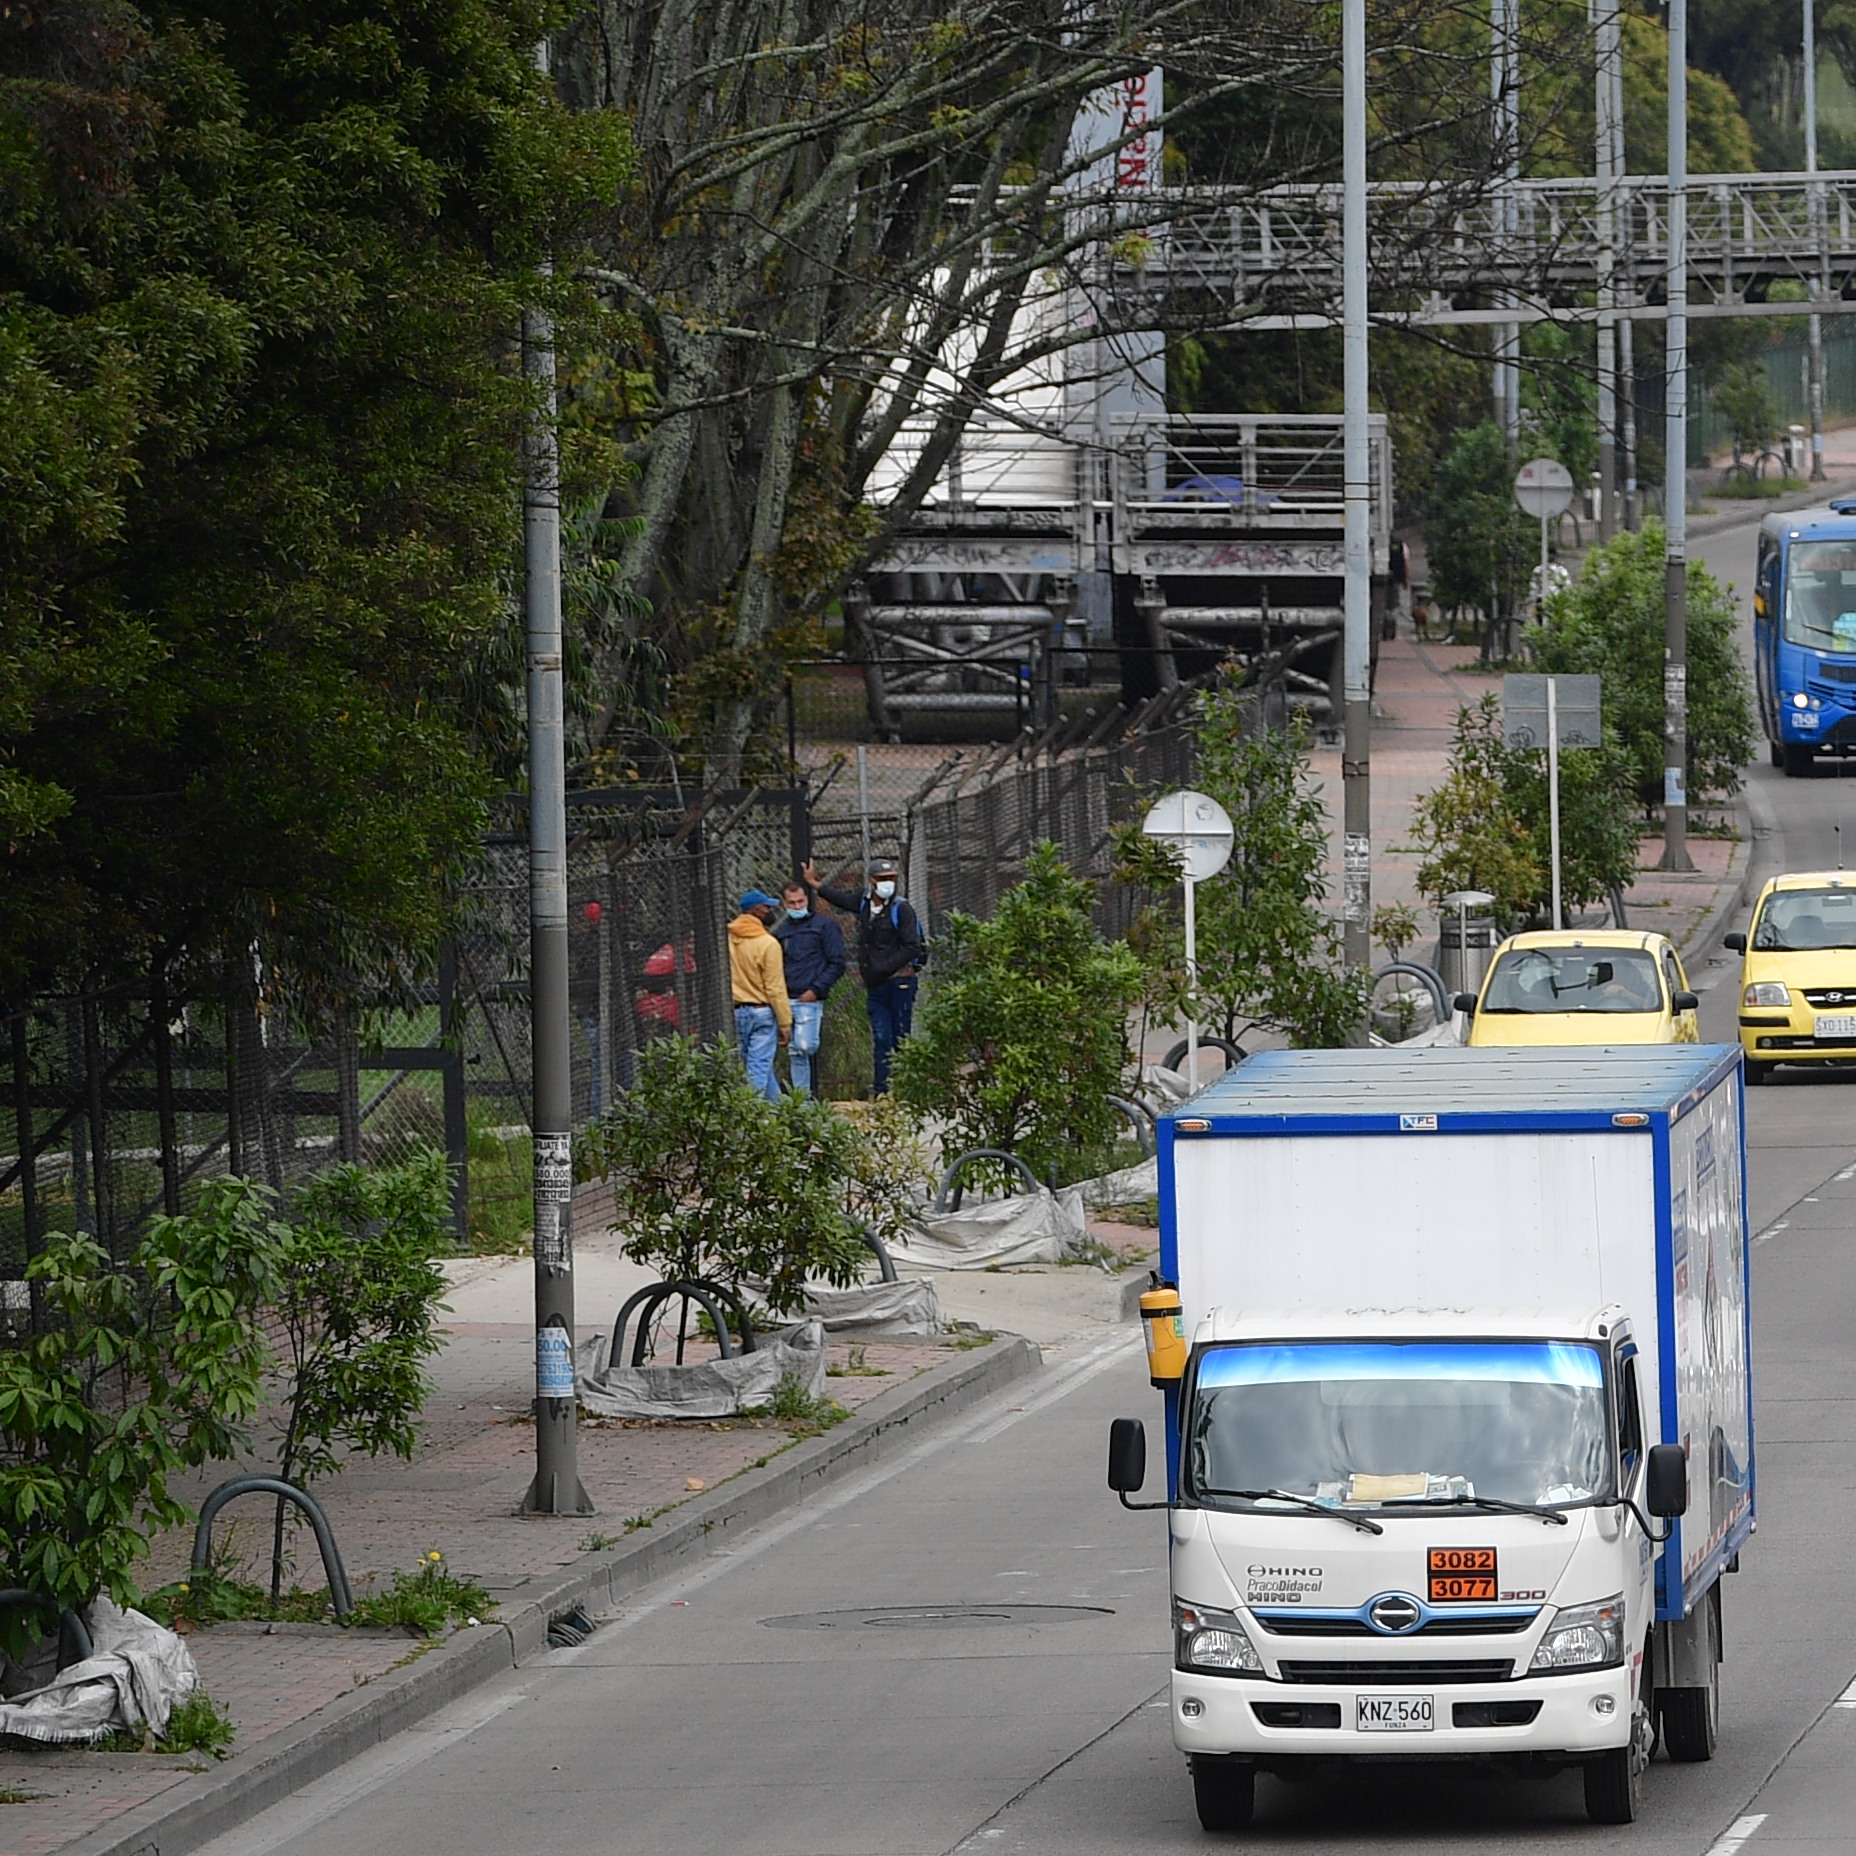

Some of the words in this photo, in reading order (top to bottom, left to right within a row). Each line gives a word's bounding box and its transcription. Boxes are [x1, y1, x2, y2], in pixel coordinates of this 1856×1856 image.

[1433, 1551, 1491, 1569] 3082
[1268, 1567, 1324, 1577] HINO
[1247, 1578, 1323, 1593] PracoDidacol
[1435, 1578, 1493, 1597] 3077
[1247, 1591, 1302, 1603] HINO
[1500, 1590, 1546, 1600] 300
